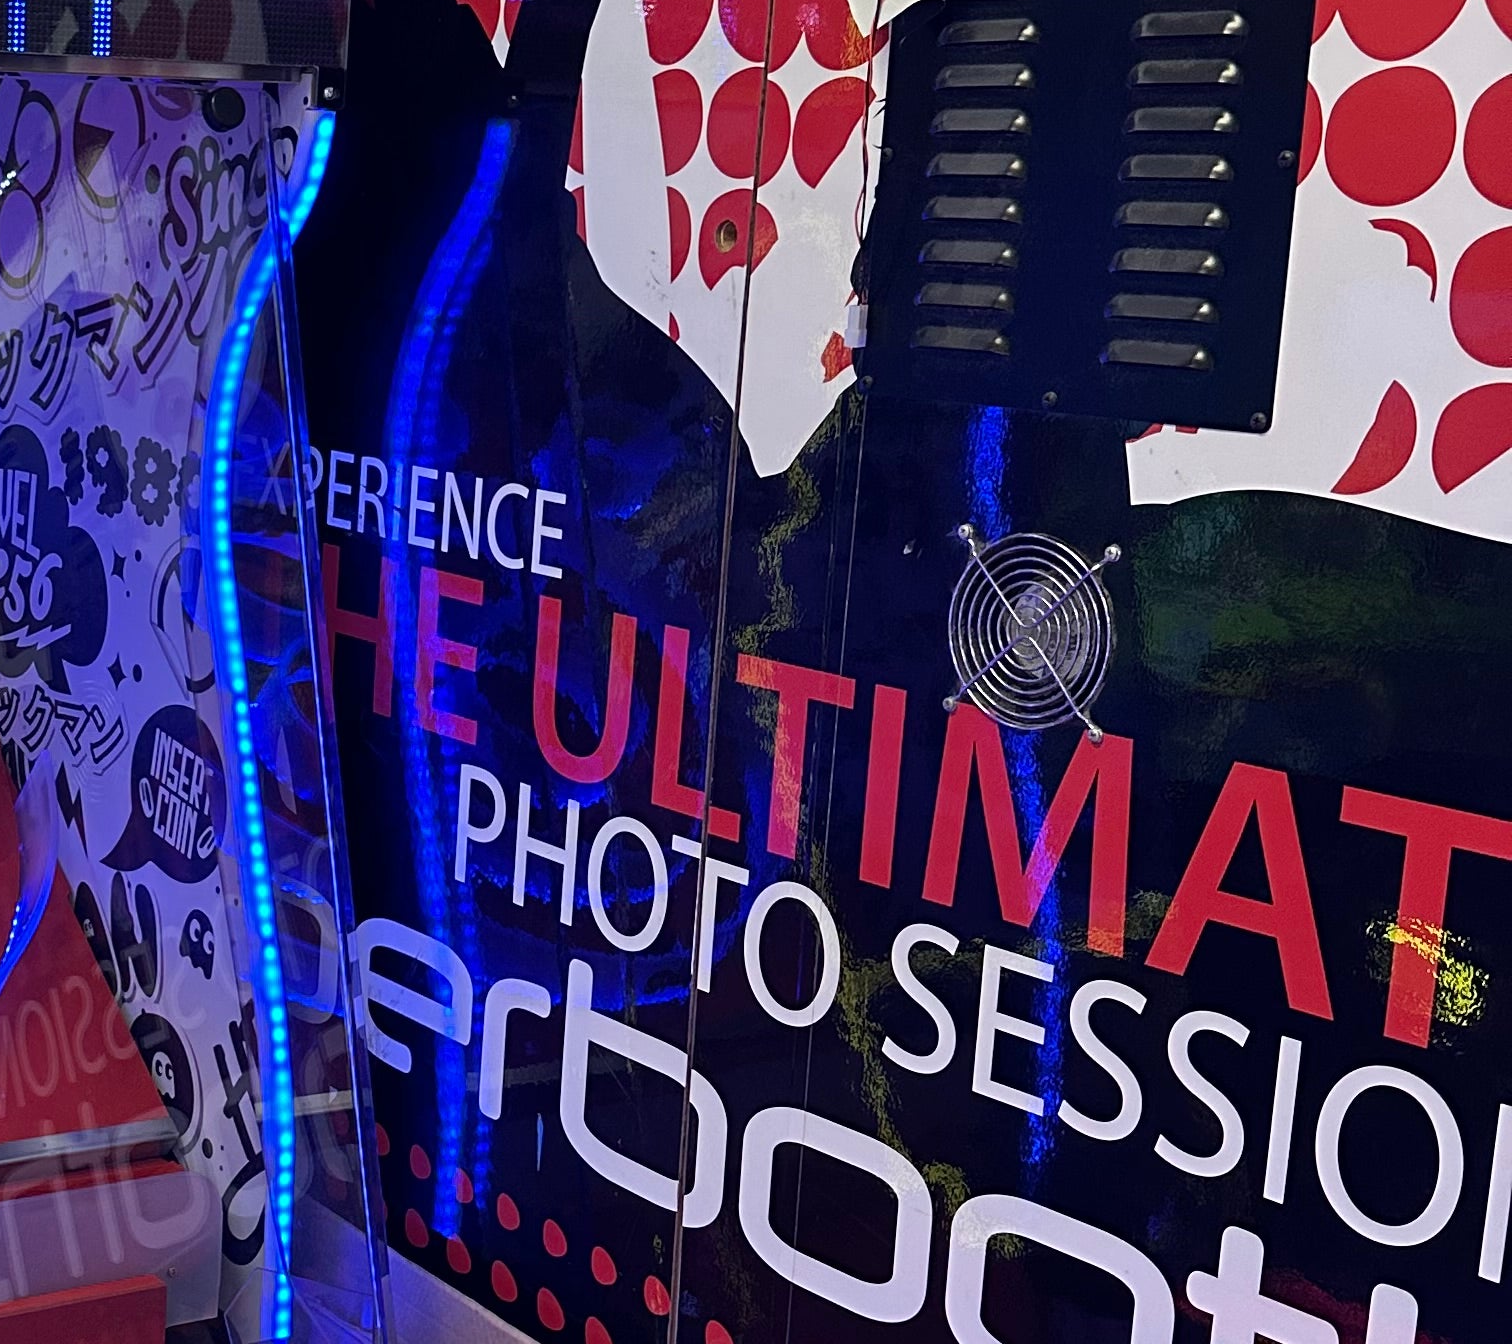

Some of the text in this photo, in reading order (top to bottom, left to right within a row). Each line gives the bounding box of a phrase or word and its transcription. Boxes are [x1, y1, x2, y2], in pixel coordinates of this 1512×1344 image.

[264, 532, 484, 746] HE
[152, 785, 199, 861] COIN
[454, 763, 841, 1027] PHOTO
